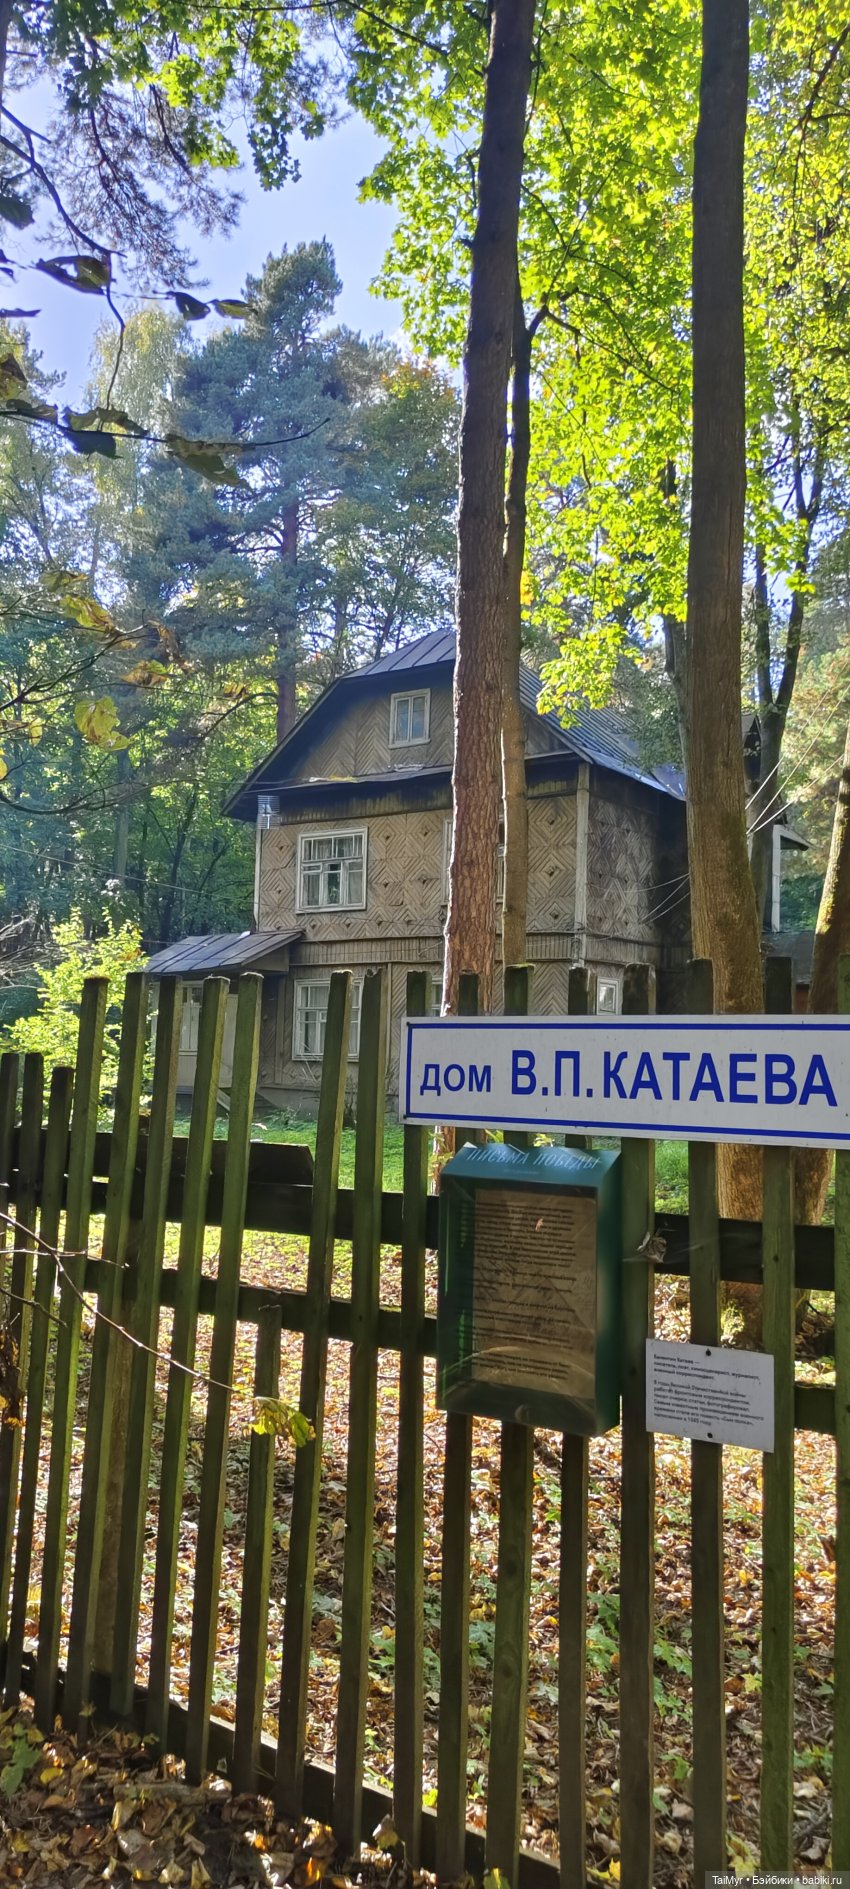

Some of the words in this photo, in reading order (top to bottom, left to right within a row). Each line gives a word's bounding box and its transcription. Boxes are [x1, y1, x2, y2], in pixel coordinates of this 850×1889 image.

[603, 1050, 838, 1107] КАТАЕВА
[466, 1148, 530, 1164] ПИСЬМА
[533, 1152, 601, 1170] ПОБЕДЫ
